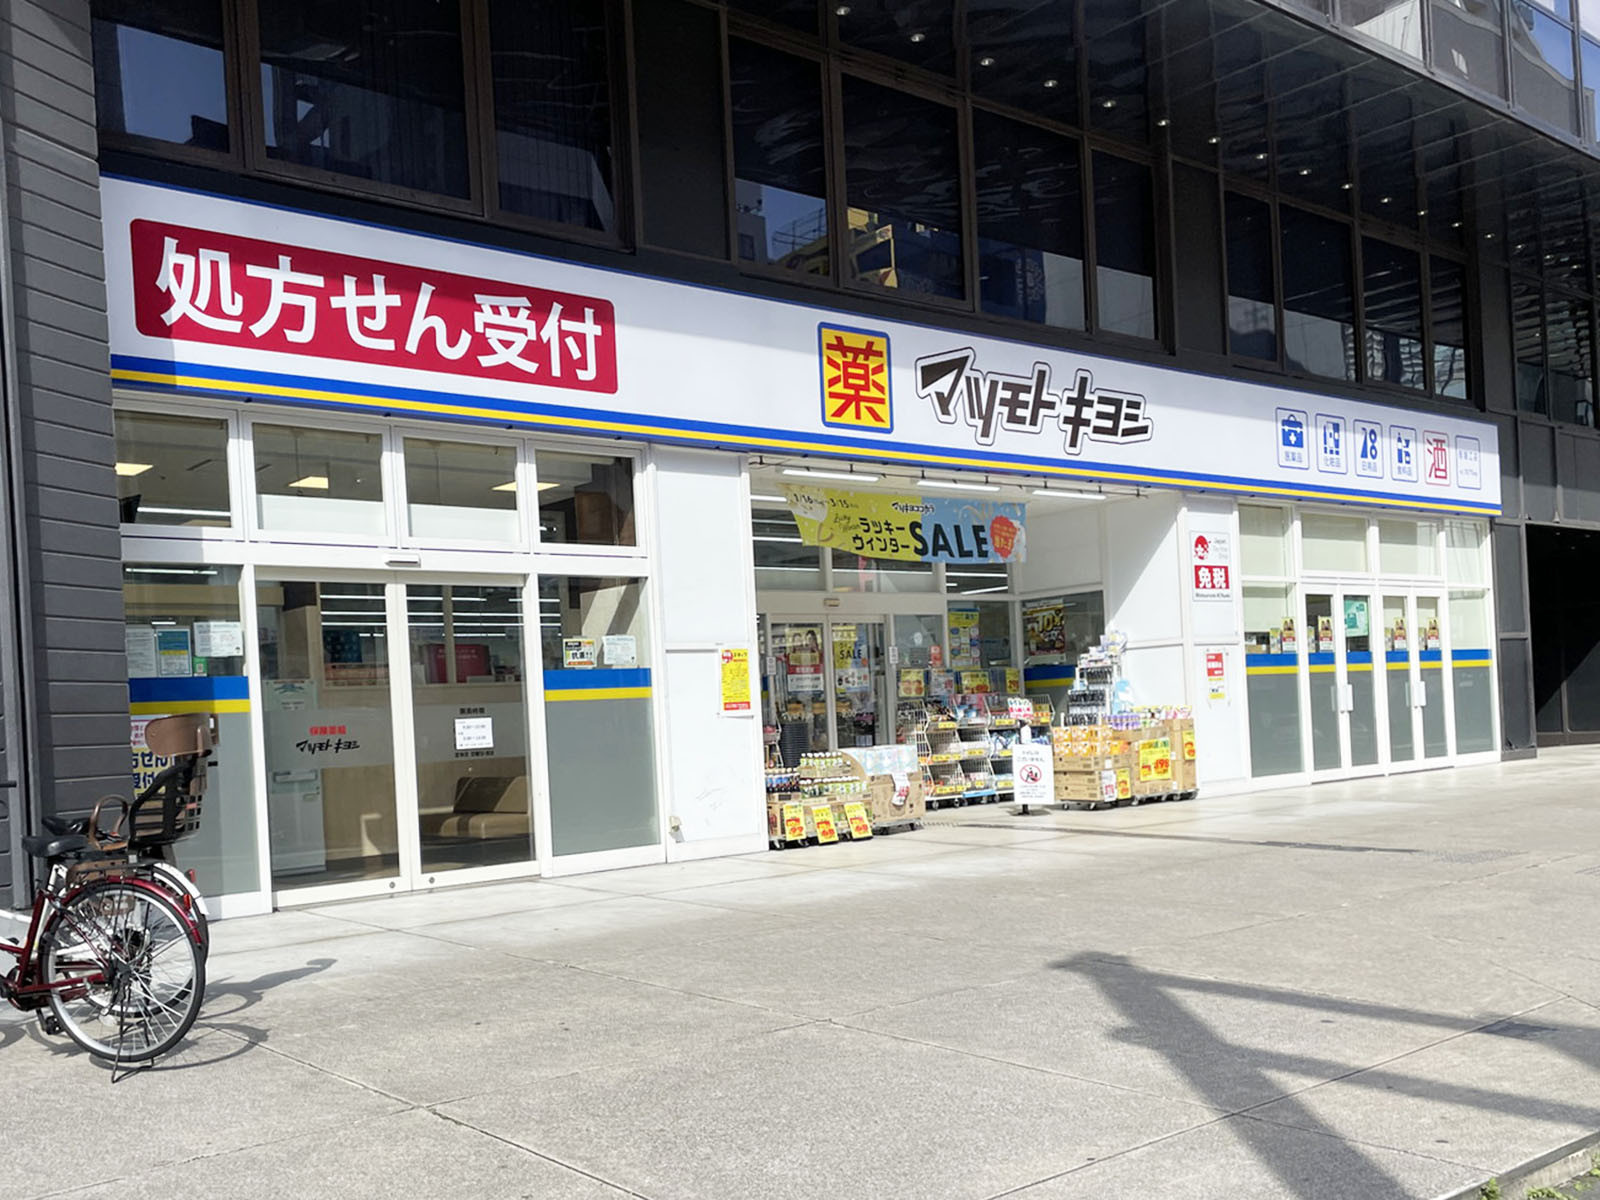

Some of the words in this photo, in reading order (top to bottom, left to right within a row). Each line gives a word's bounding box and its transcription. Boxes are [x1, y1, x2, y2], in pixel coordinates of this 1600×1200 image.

[155, 236, 603, 382] 処方せん受付
[825, 335, 886, 423] 薬
[918, 350, 1151, 450] マツモトキヨシ
[1426, 438, 1447, 479] 酒
[858, 516, 905, 535] ラッキー
[909, 520, 989, 559] SALE
[1198, 566, 1226, 589] 免税
[840, 649, 862, 660] SALE
[296, 738, 360, 754] マツモトキヨシ
